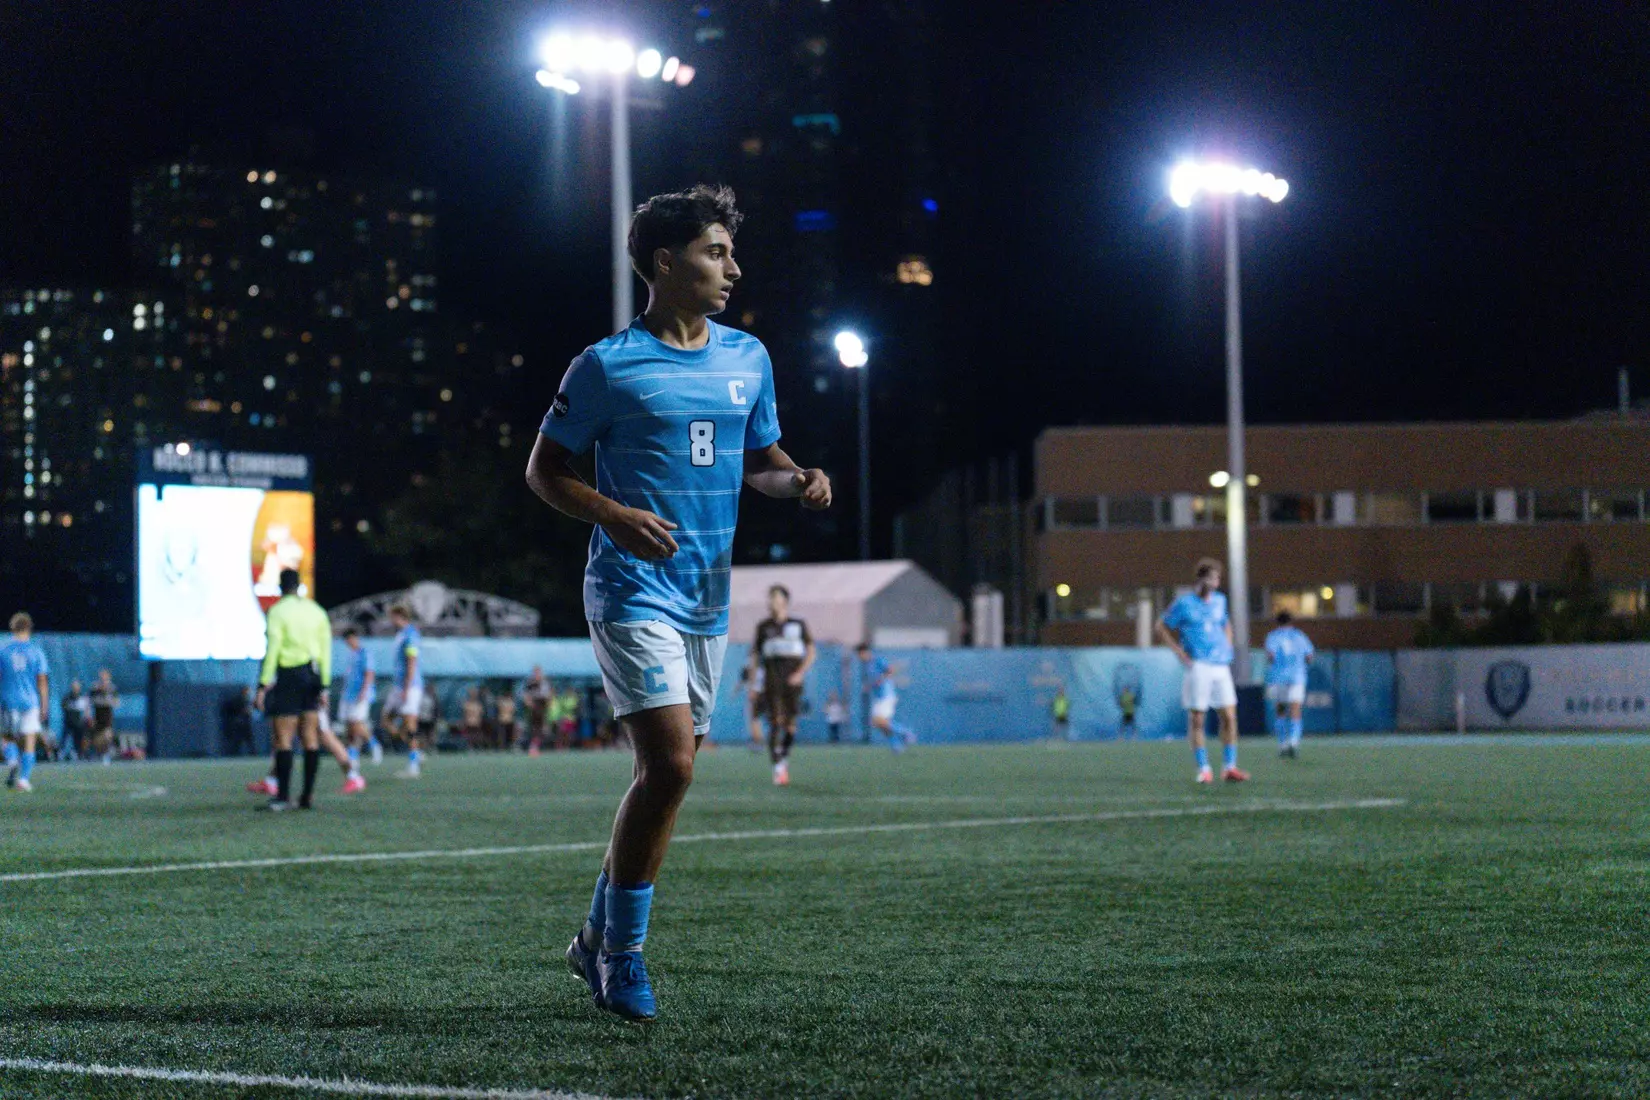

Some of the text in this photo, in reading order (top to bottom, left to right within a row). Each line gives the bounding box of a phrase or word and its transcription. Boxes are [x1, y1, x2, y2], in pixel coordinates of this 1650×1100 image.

[728, 380, 746, 405] C
[688, 420, 716, 467] 8
[643, 665, 669, 694] C
